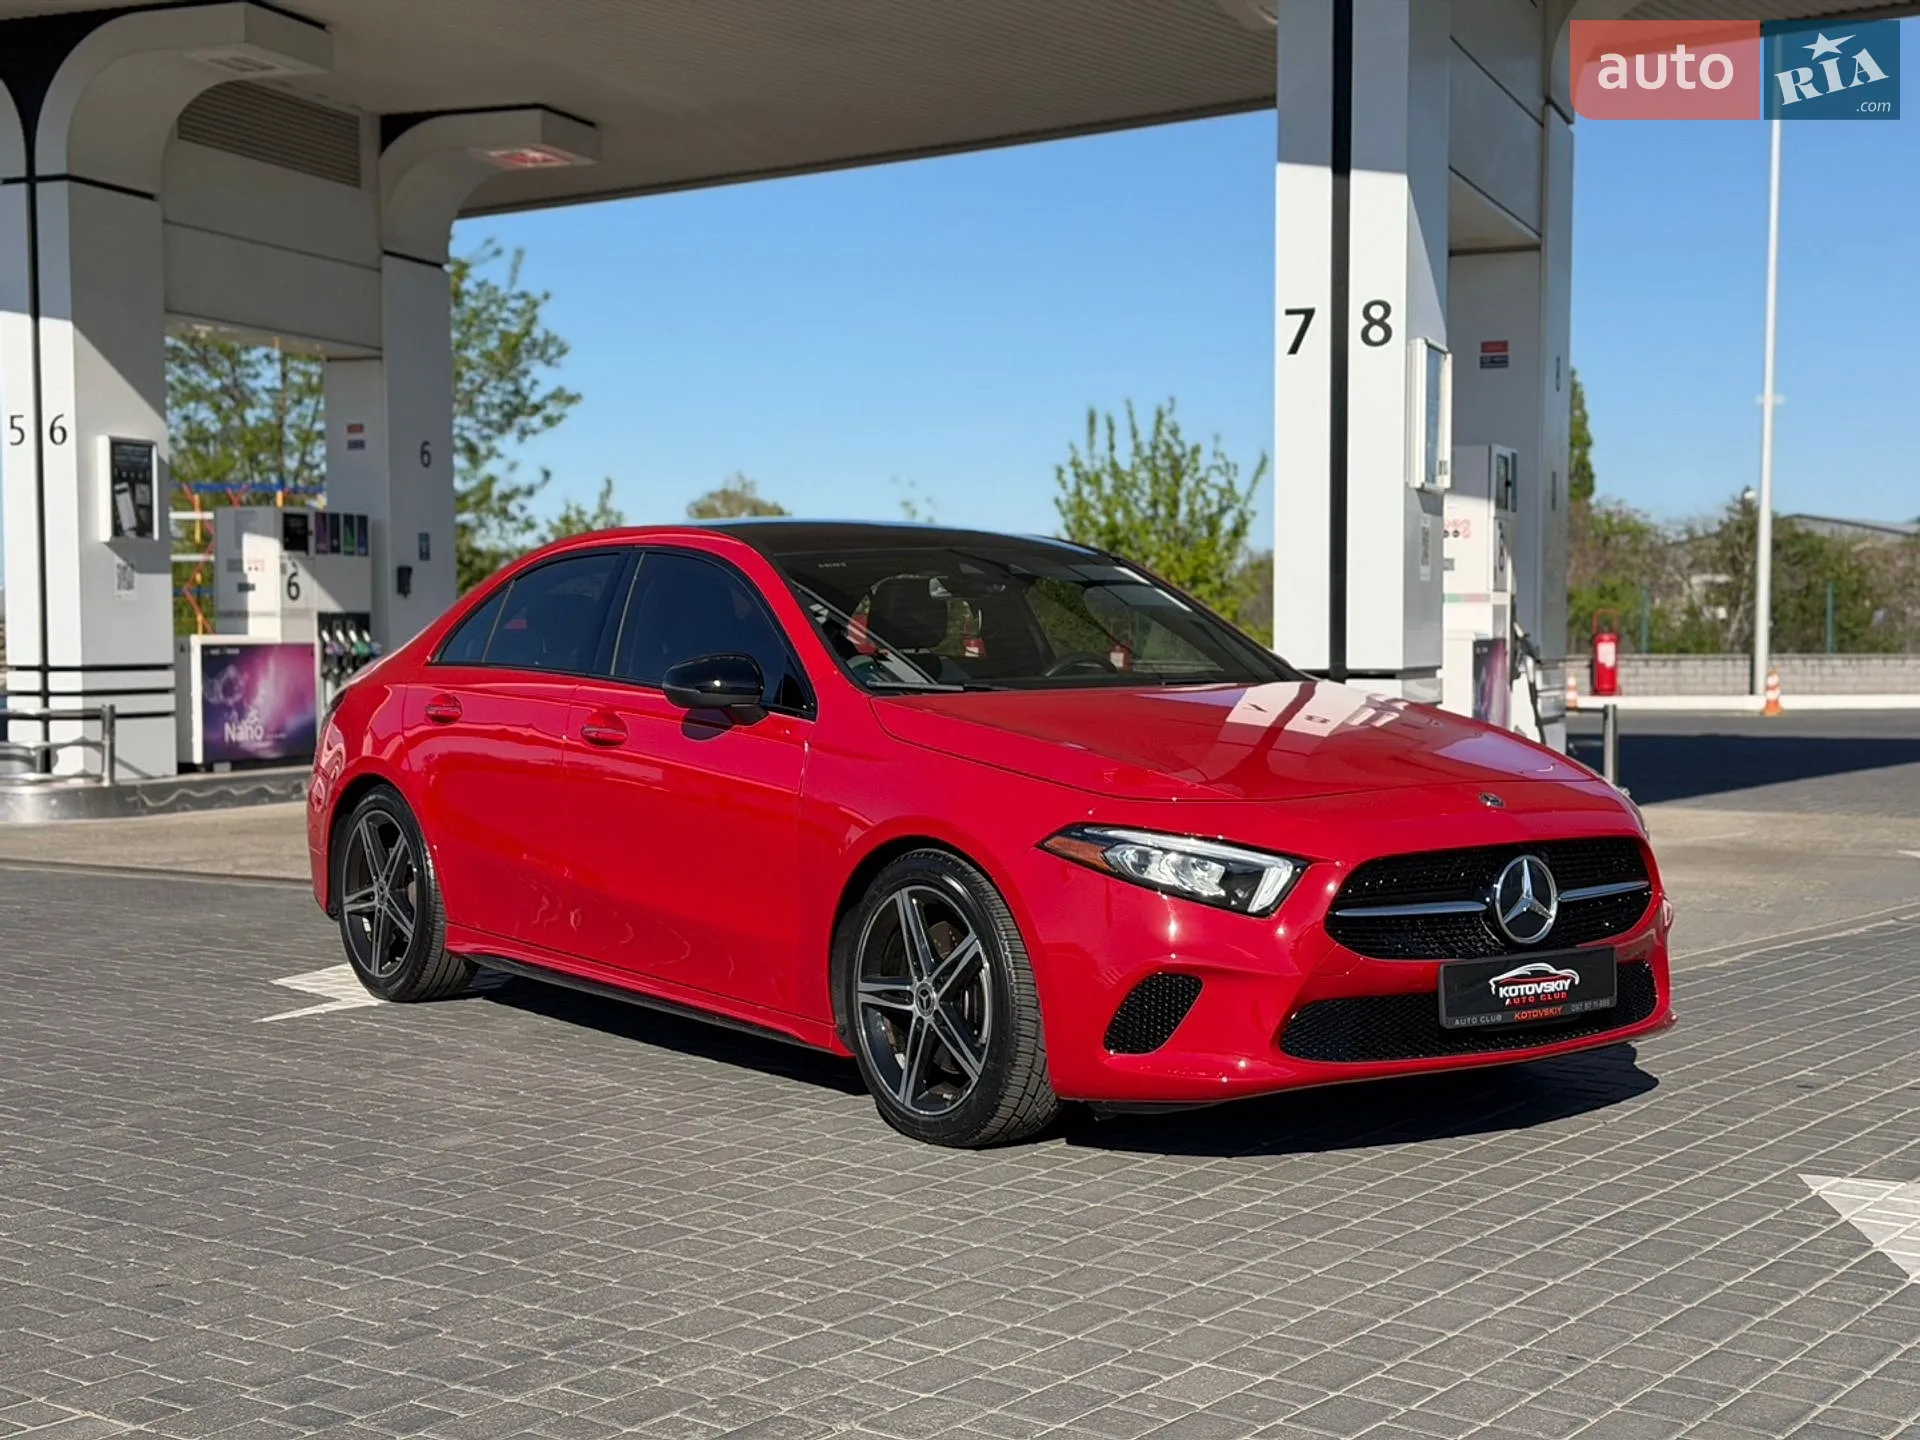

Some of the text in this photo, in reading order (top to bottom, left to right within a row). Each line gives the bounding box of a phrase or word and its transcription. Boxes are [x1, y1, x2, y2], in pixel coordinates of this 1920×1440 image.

[1284, 307, 1316, 355] 7
[1360, 299, 1393, 347] 8
[9, 414, 26, 446] 5
[49, 413, 68, 446] 6
[419, 440, 432, 469] 6
[287, 572, 300, 601] 6
[1499, 979, 1571, 998] KOTOVSKIY
[1505, 991, 1567, 1006] AUTO CLUB
[1454, 1016, 1479, 1026] AUTO
[1480, 1014, 1502, 1024] CLUB
[1513, 1006, 1564, 1021] KOTOVSKIY
